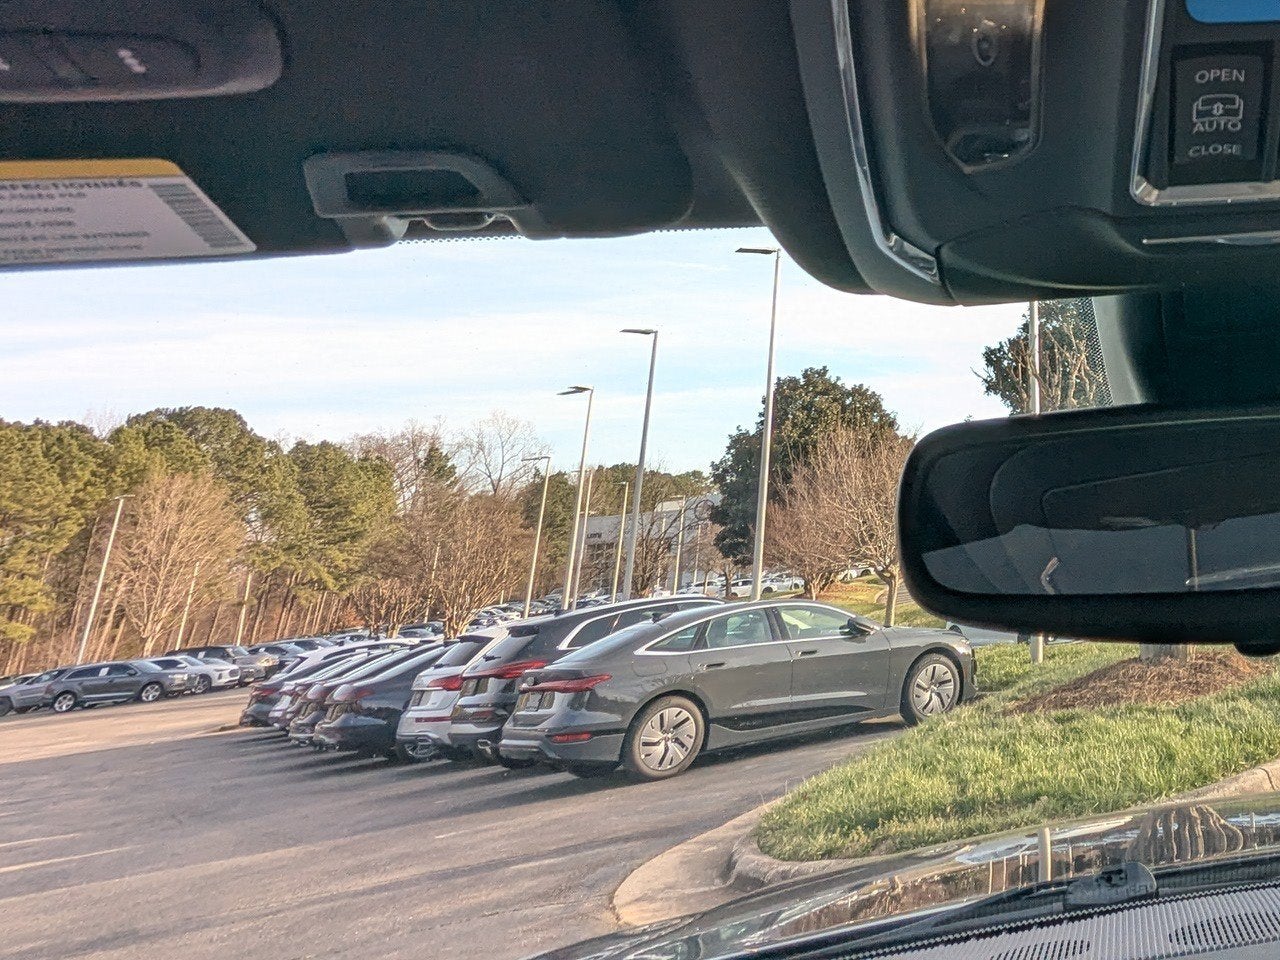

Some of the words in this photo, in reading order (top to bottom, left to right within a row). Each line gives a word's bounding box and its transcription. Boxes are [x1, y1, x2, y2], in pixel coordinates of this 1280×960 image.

[1194, 67, 1246, 83] OPEN
[1192, 119, 1243, 134] AUTO
[1188, 144, 1242, 158] CLOSE
